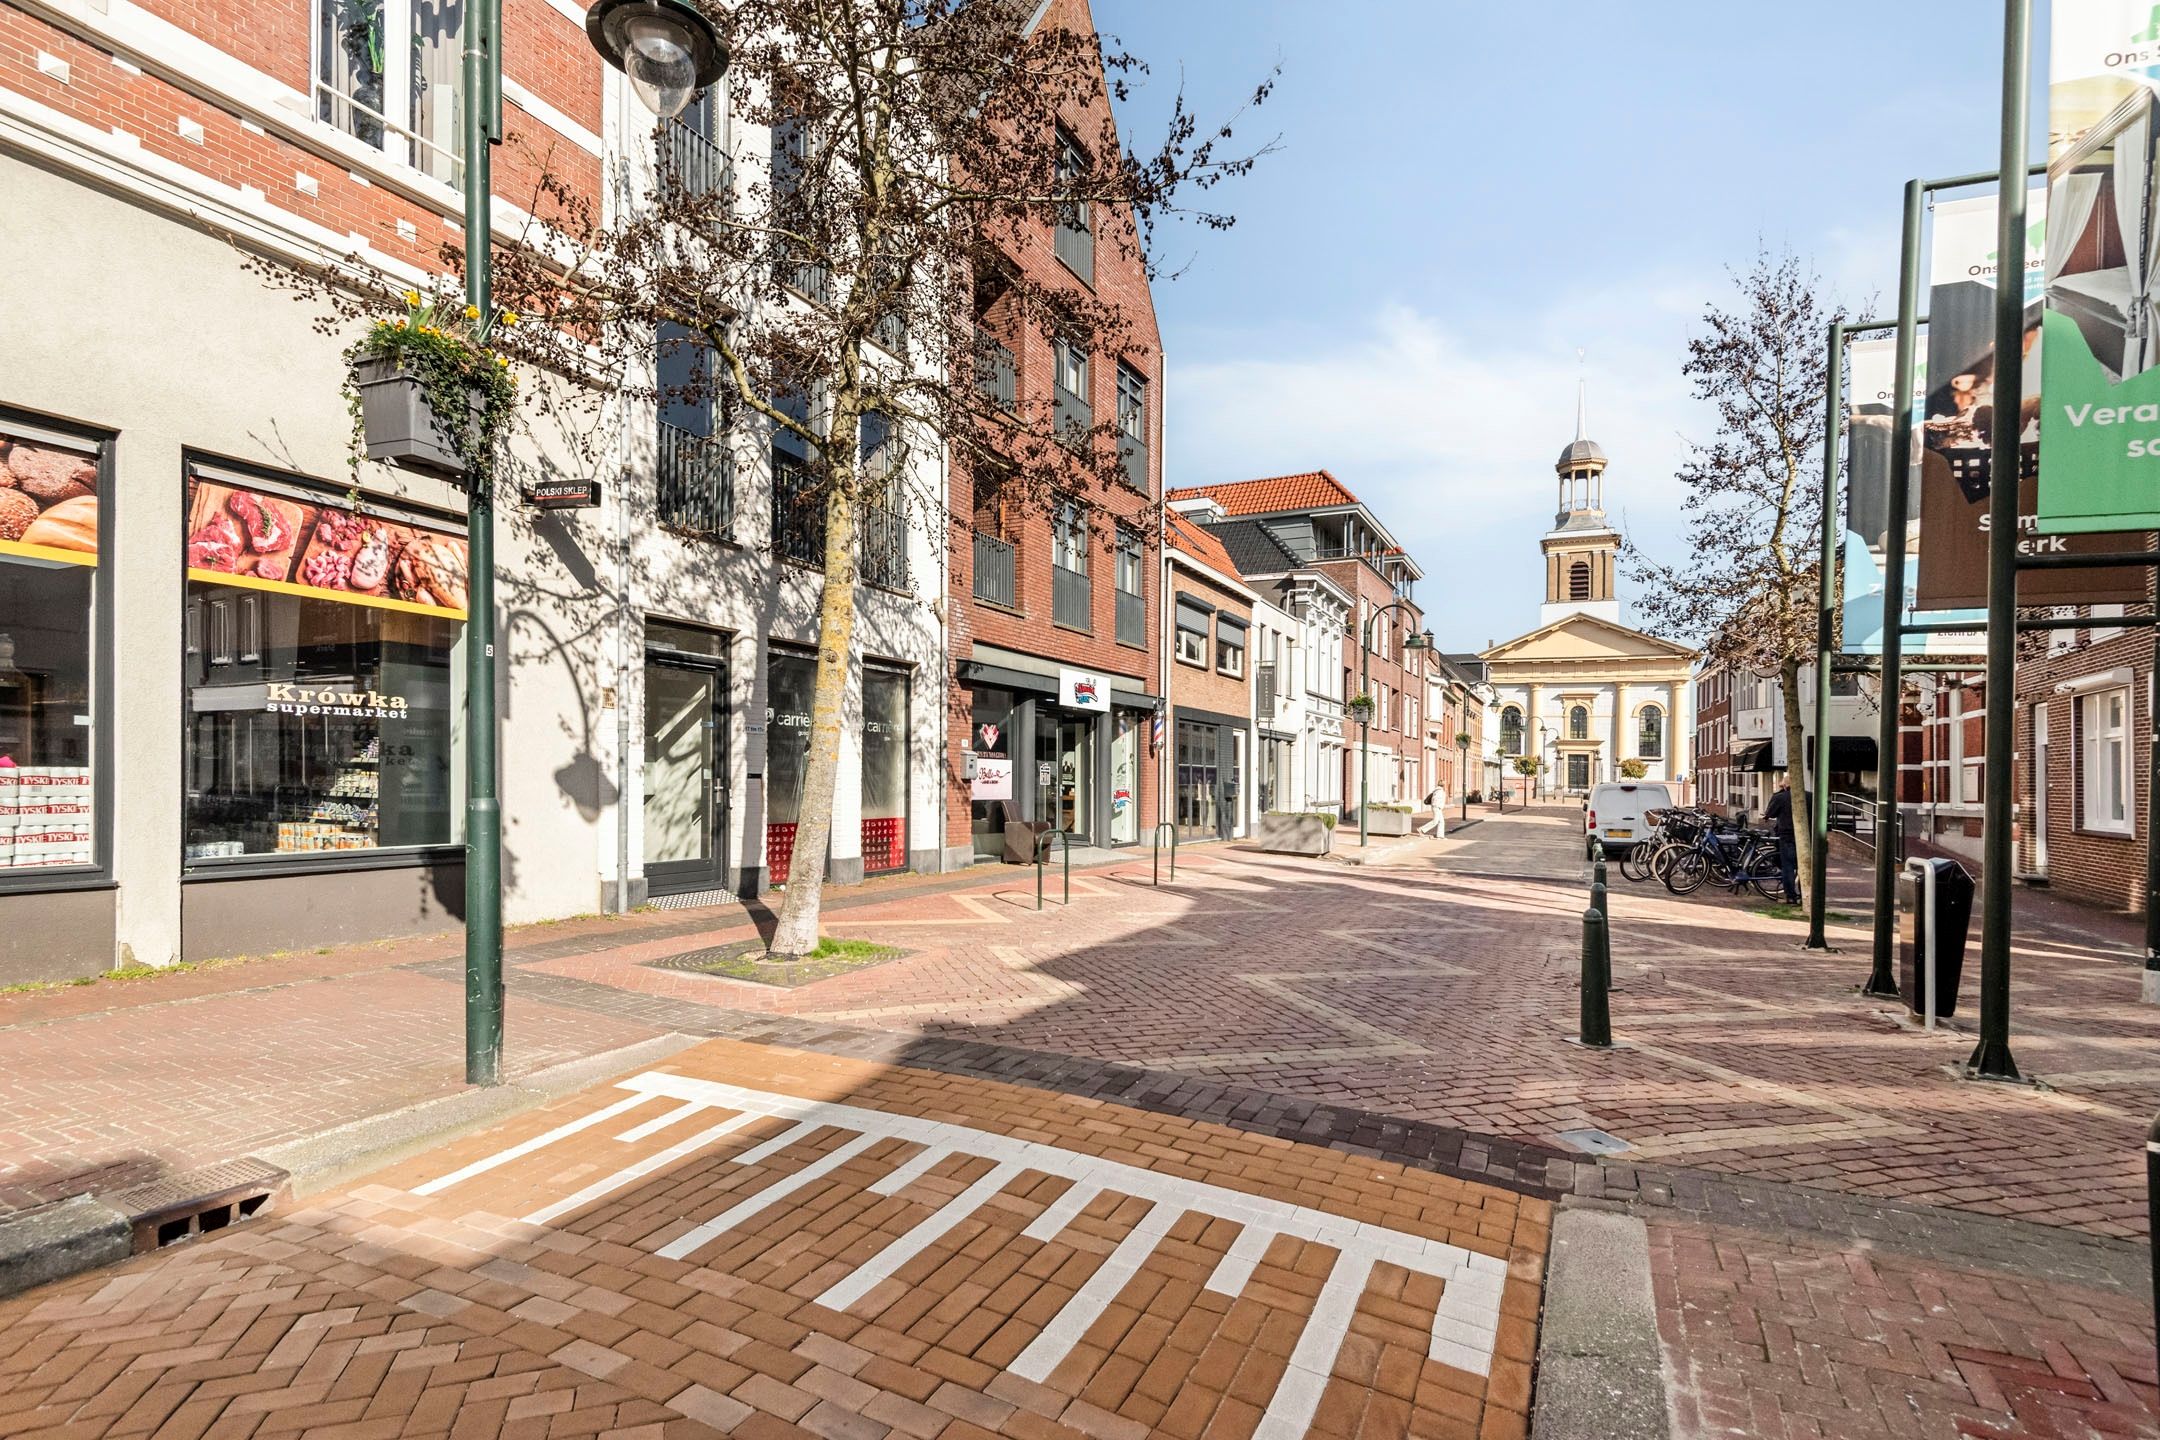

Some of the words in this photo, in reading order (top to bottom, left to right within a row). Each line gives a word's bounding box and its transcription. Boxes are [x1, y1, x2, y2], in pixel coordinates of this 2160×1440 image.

[2104, 51, 2150, 68] Ons
[2063, 403, 2158, 427] Vera
[536, 487, 562, 497] POLSKI
[563, 486, 587, 495] SKLEP
[2017, 535, 2067, 554] erk
[267, 683, 408, 709] Krówka
[266, 702, 408, 719] supermarket
[776, 711, 812, 728] carriè
